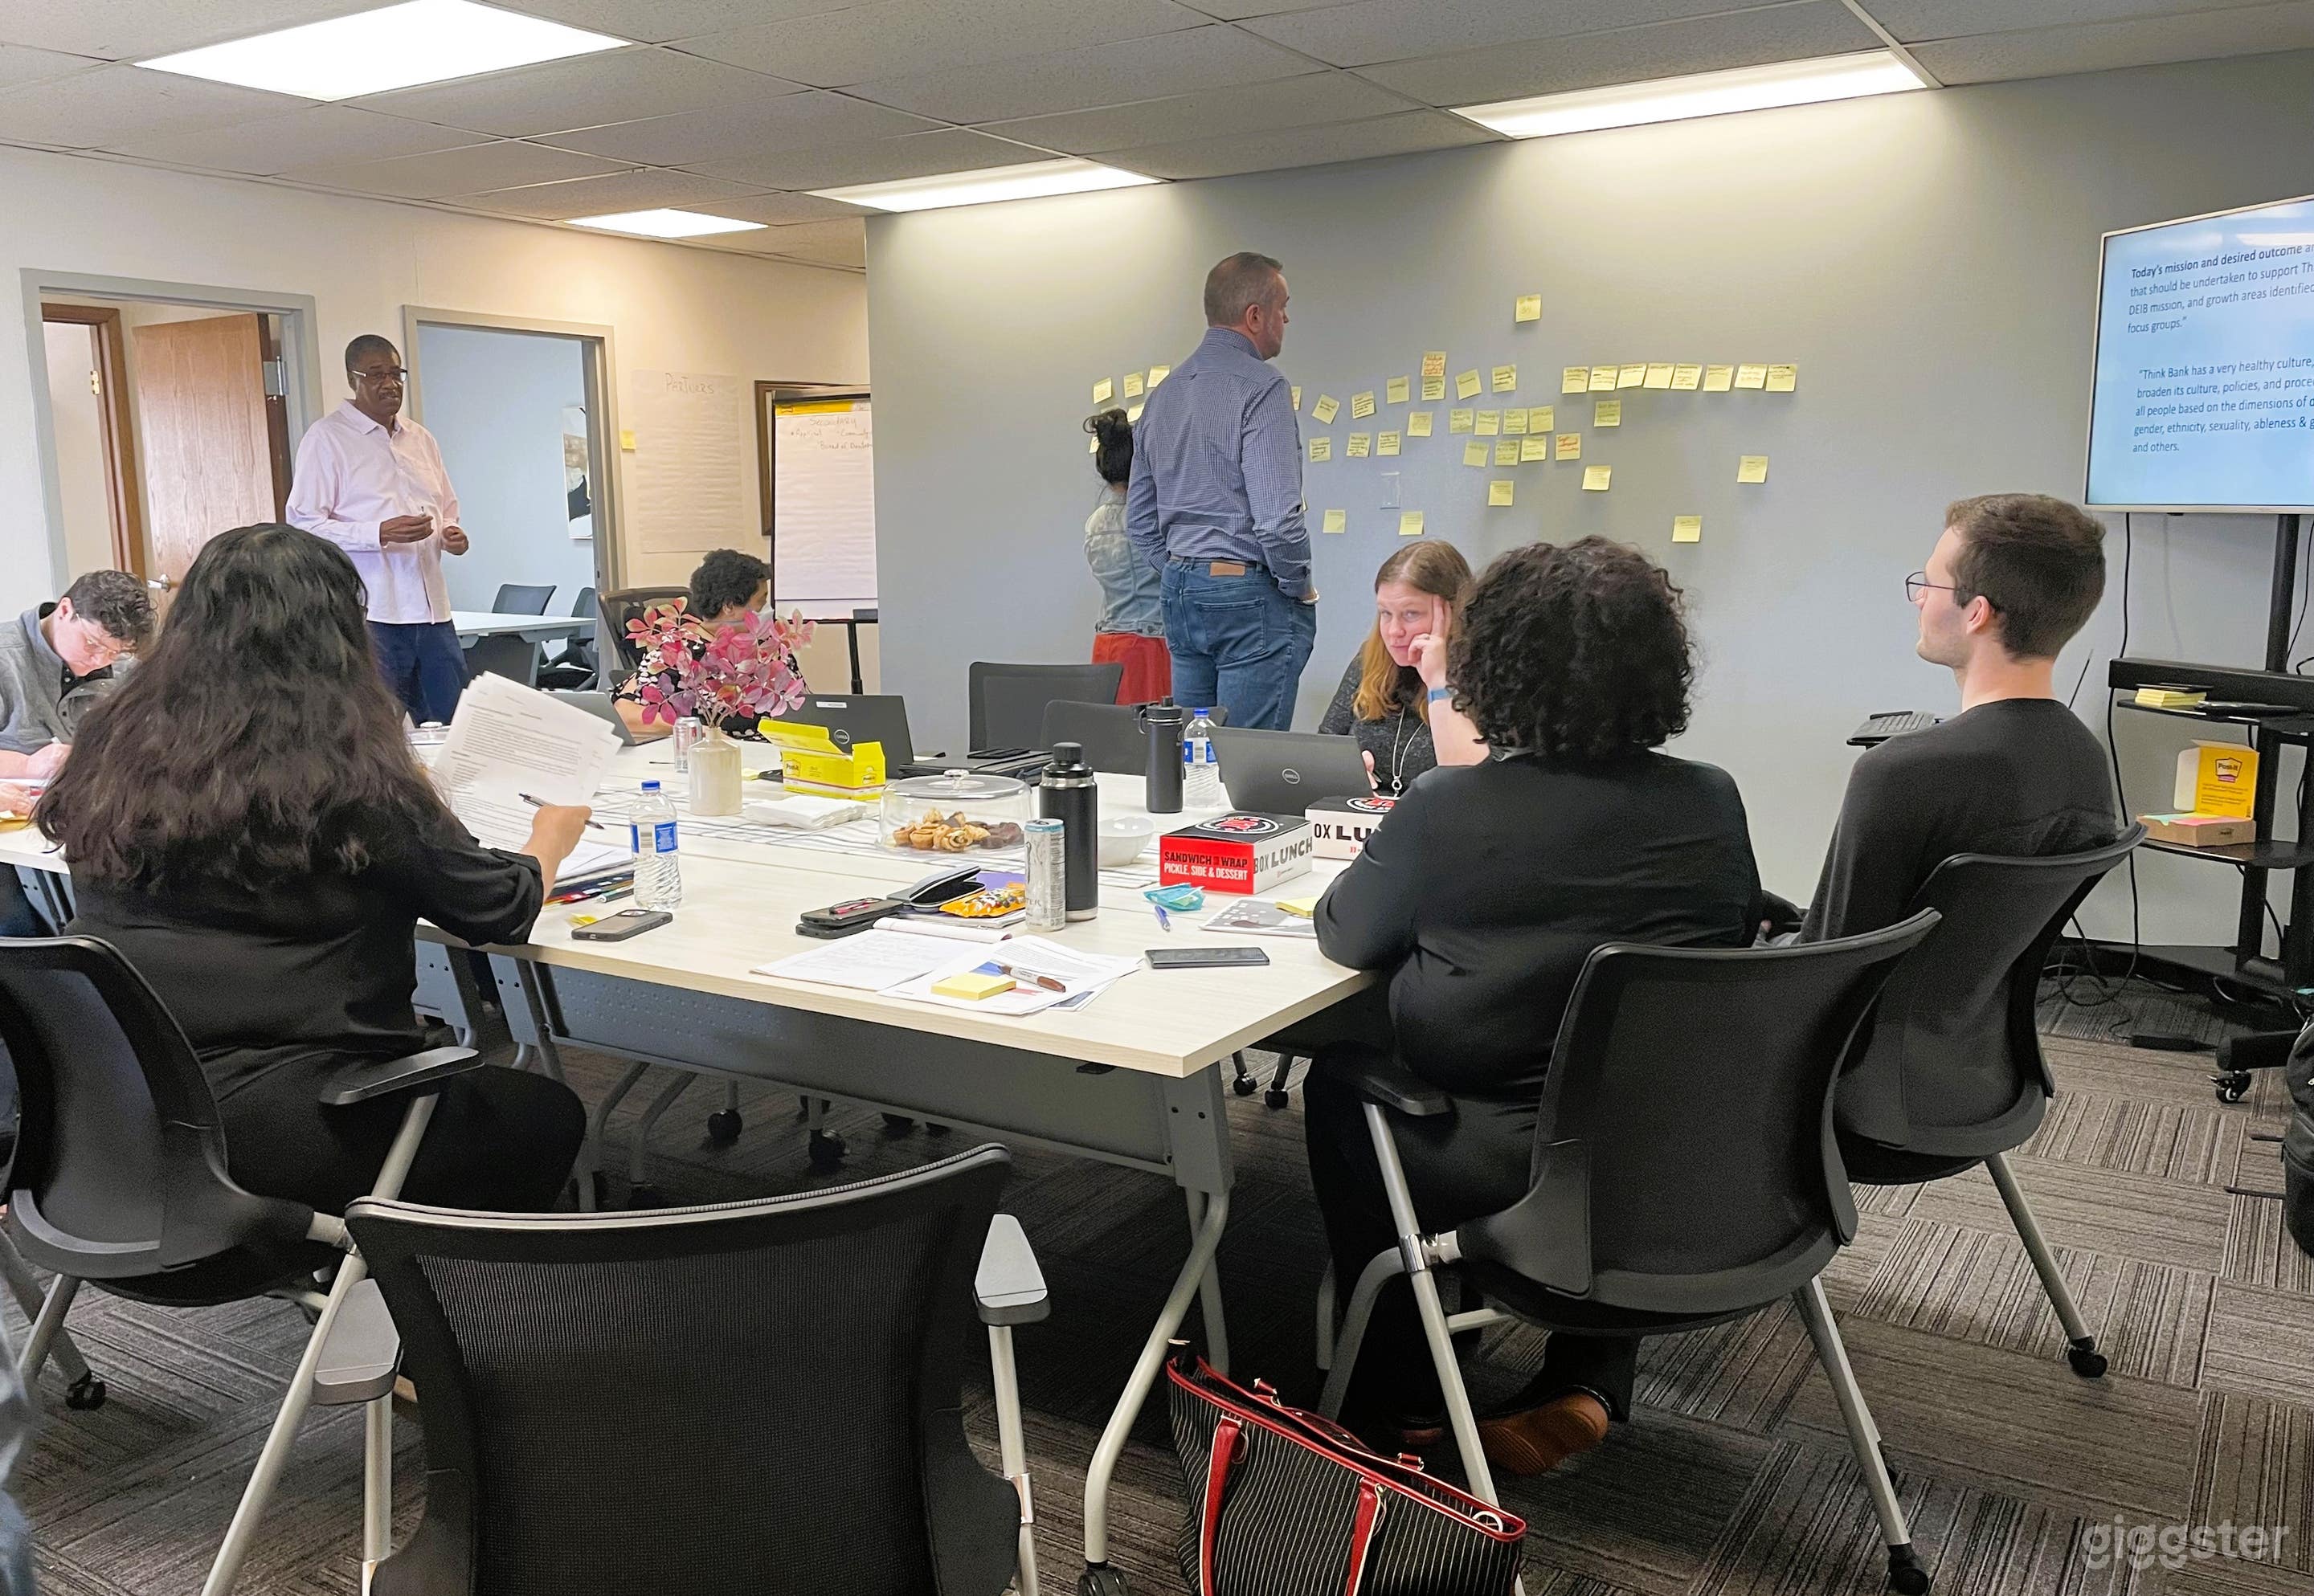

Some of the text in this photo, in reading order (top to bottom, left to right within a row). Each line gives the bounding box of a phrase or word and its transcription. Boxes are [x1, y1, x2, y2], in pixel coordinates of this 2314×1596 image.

[2132, 265, 2162, 279] Today's
[2165, 261, 2198, 273] mission
[2201, 255, 2218, 267] and
[2221, 250, 2255, 265] desired
[2259, 245, 2302, 259] outcome
[2130, 287, 2147, 297] that
[2149, 280, 2177, 295] should
[2180, 280, 2191, 290] be
[2193, 272, 2245, 288] undertaken
[2248, 271, 2258, 280] to
[2260, 265, 2298, 281] support
[2129, 304, 2148, 316] DEIB
[2150, 301, 2185, 312] mission,
[2188, 296, 2204, 308] and
[2206, 292, 2238, 308] growth
[2241, 291, 2267, 300] areas
[2128, 323, 2149, 333] focus
[2169, 365, 2189, 378] Bank
[2191, 365, 2206, 376] has
[2217, 364, 2237, 374] very
[2238, 359, 2275, 372] healthy
[2136, 378, 2314, 398] broaden its culture, policies, and proce
[2135, 406, 2145, 416] all
[2147, 405, 2176, 418] people
[2178, 402, 2204, 414] based
[2206, 403, 2218, 412] on
[2221, 401, 2236, 412] the
[2238, 397, 2293, 410] dimensions
[2296, 395, 2308, 407] of
[2134, 424, 2165, 437] gender,
[2167, 422, 2207, 434] ethnicity,
[2209, 419, 2251, 432] sexuality,
[2254, 417, 2296, 429] ableness
[2299, 416, 2307, 427] &
[2132, 441, 2180, 452] and others.
[1314, 823, 1331, 839] OX
[1164, 851, 1212, 865] SANDWICH
[1221, 857, 1248, 868] WRAP
[1253, 854, 1269, 874] BOX
[1271, 836, 1313, 868] LUNCH
[1191, 865, 1207, 877] SIDE
[1208, 867, 1216, 878] &
[1216, 868, 1248, 881] DESSERT
